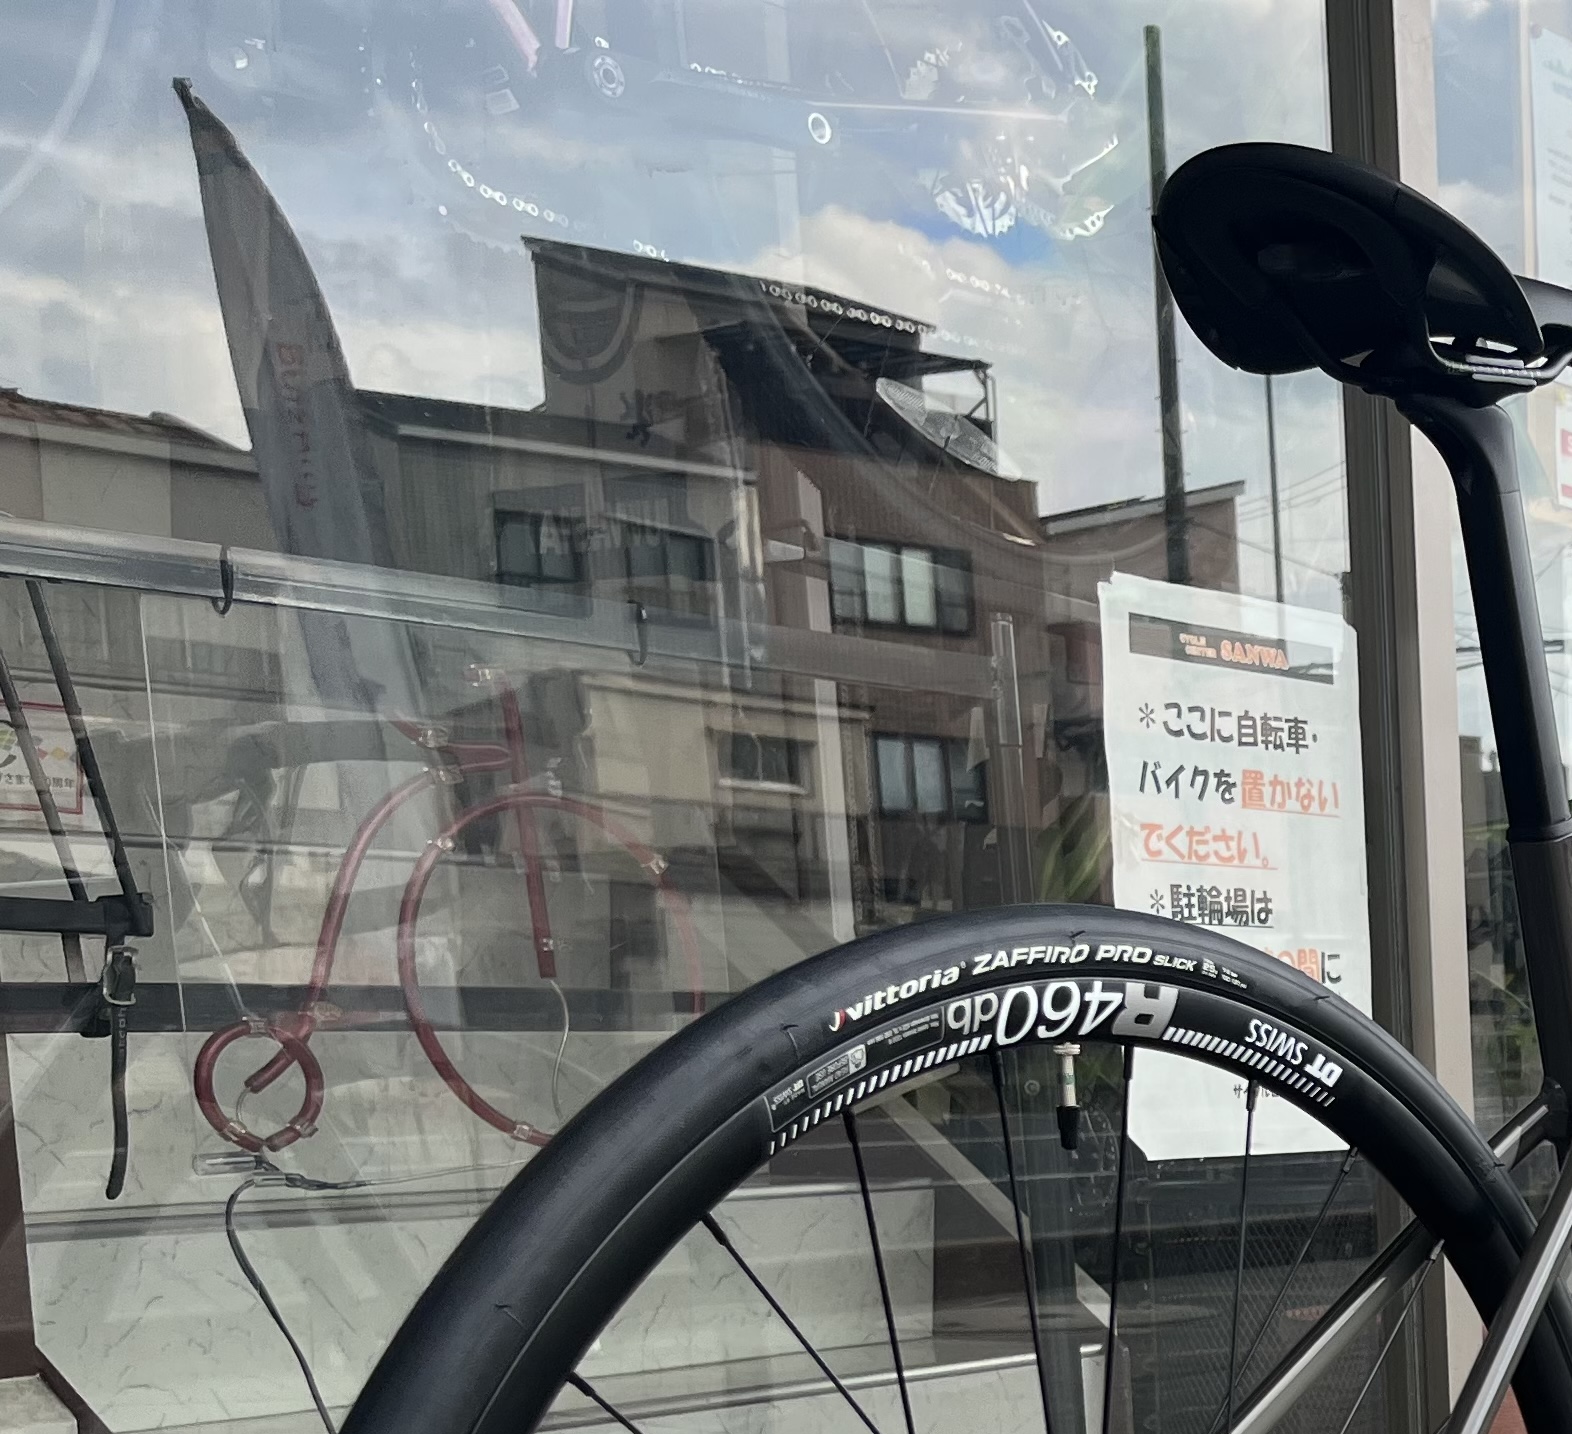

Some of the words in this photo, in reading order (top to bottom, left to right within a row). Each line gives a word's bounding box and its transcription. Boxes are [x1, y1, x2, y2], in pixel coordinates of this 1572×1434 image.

[1220, 639, 1290, 670] SANWA
[1139, 760, 1340, 812] バイクを置かない
[1140, 823, 1270, 868] でください。
[845, 964, 960, 1021] vittoria
[972, 943, 1089, 976] ZAFFIRO
[1095, 944, 1152, 965] PRO
[1152, 955, 1198, 972] SLICK
[1245, 1018, 1309, 1065] SWISS
[1304, 1053, 1343, 1088] DT
